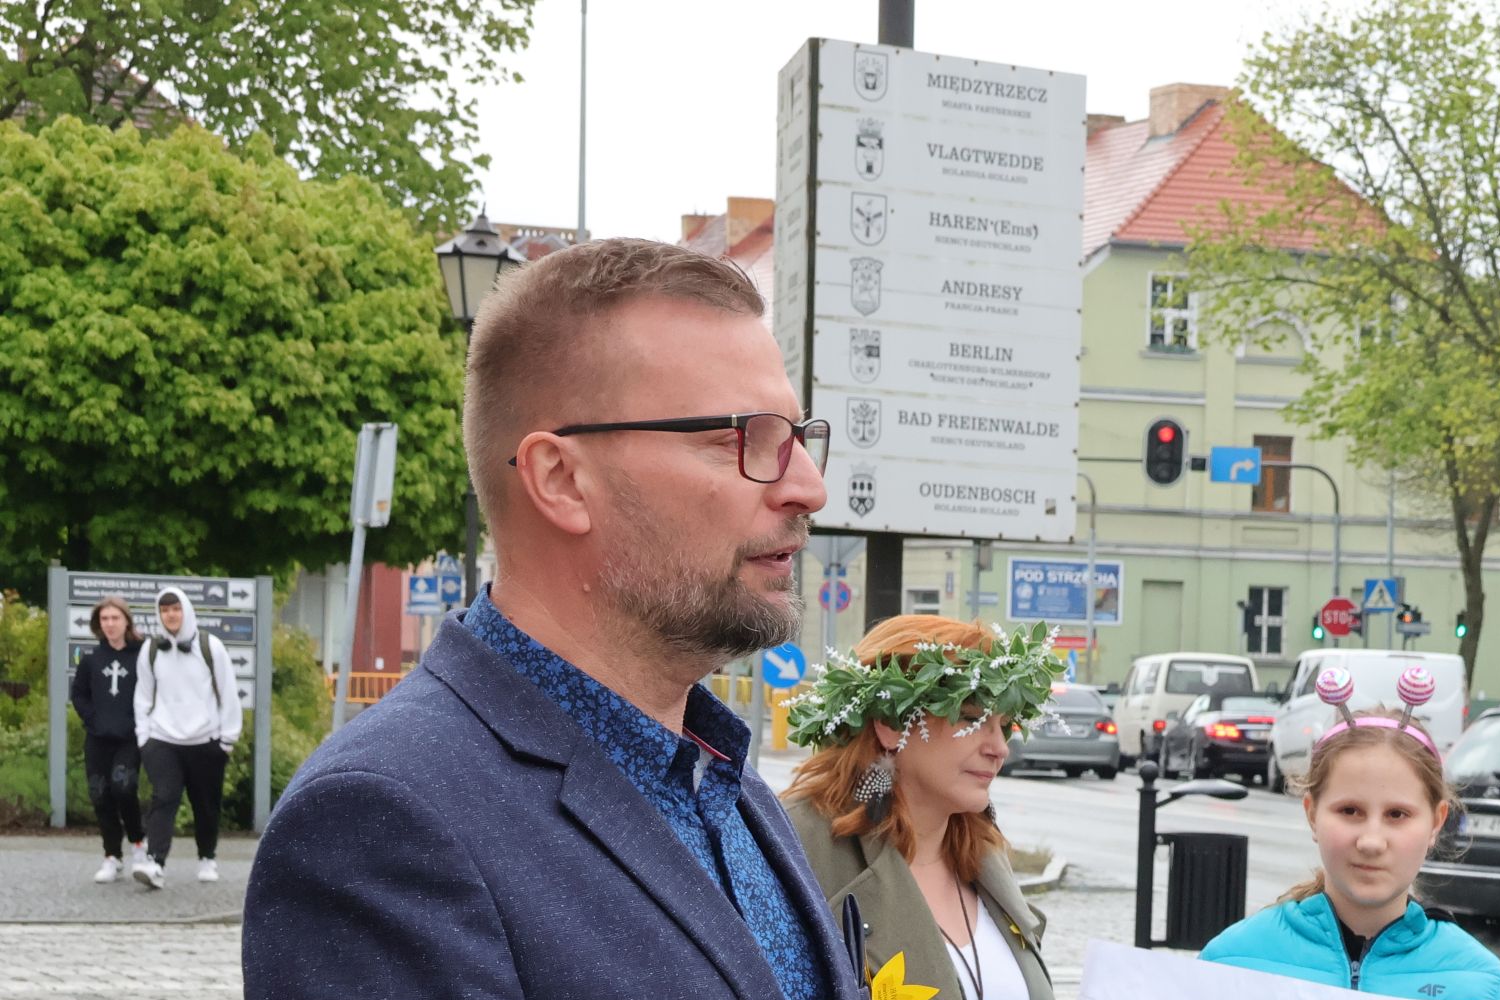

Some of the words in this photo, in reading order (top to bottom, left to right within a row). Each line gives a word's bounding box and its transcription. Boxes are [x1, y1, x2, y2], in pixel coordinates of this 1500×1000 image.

[927, 73, 1048, 103] MIĘDZYRZECZ
[927, 142, 1044, 172] VLAGTWEDDE
[929, 212, 988, 232] HAREN
[993, 220, 1039, 240] (Ems)
[941, 280, 1023, 302] ANDRESY
[949, 343, 1013, 362] BERLIN
[898, 410, 932, 427] BAD
[937, 414, 1060, 438] FREIENWALDE
[919, 482, 1036, 504] OUDENBOSCH
[1417, 983, 1446, 998] 4F
